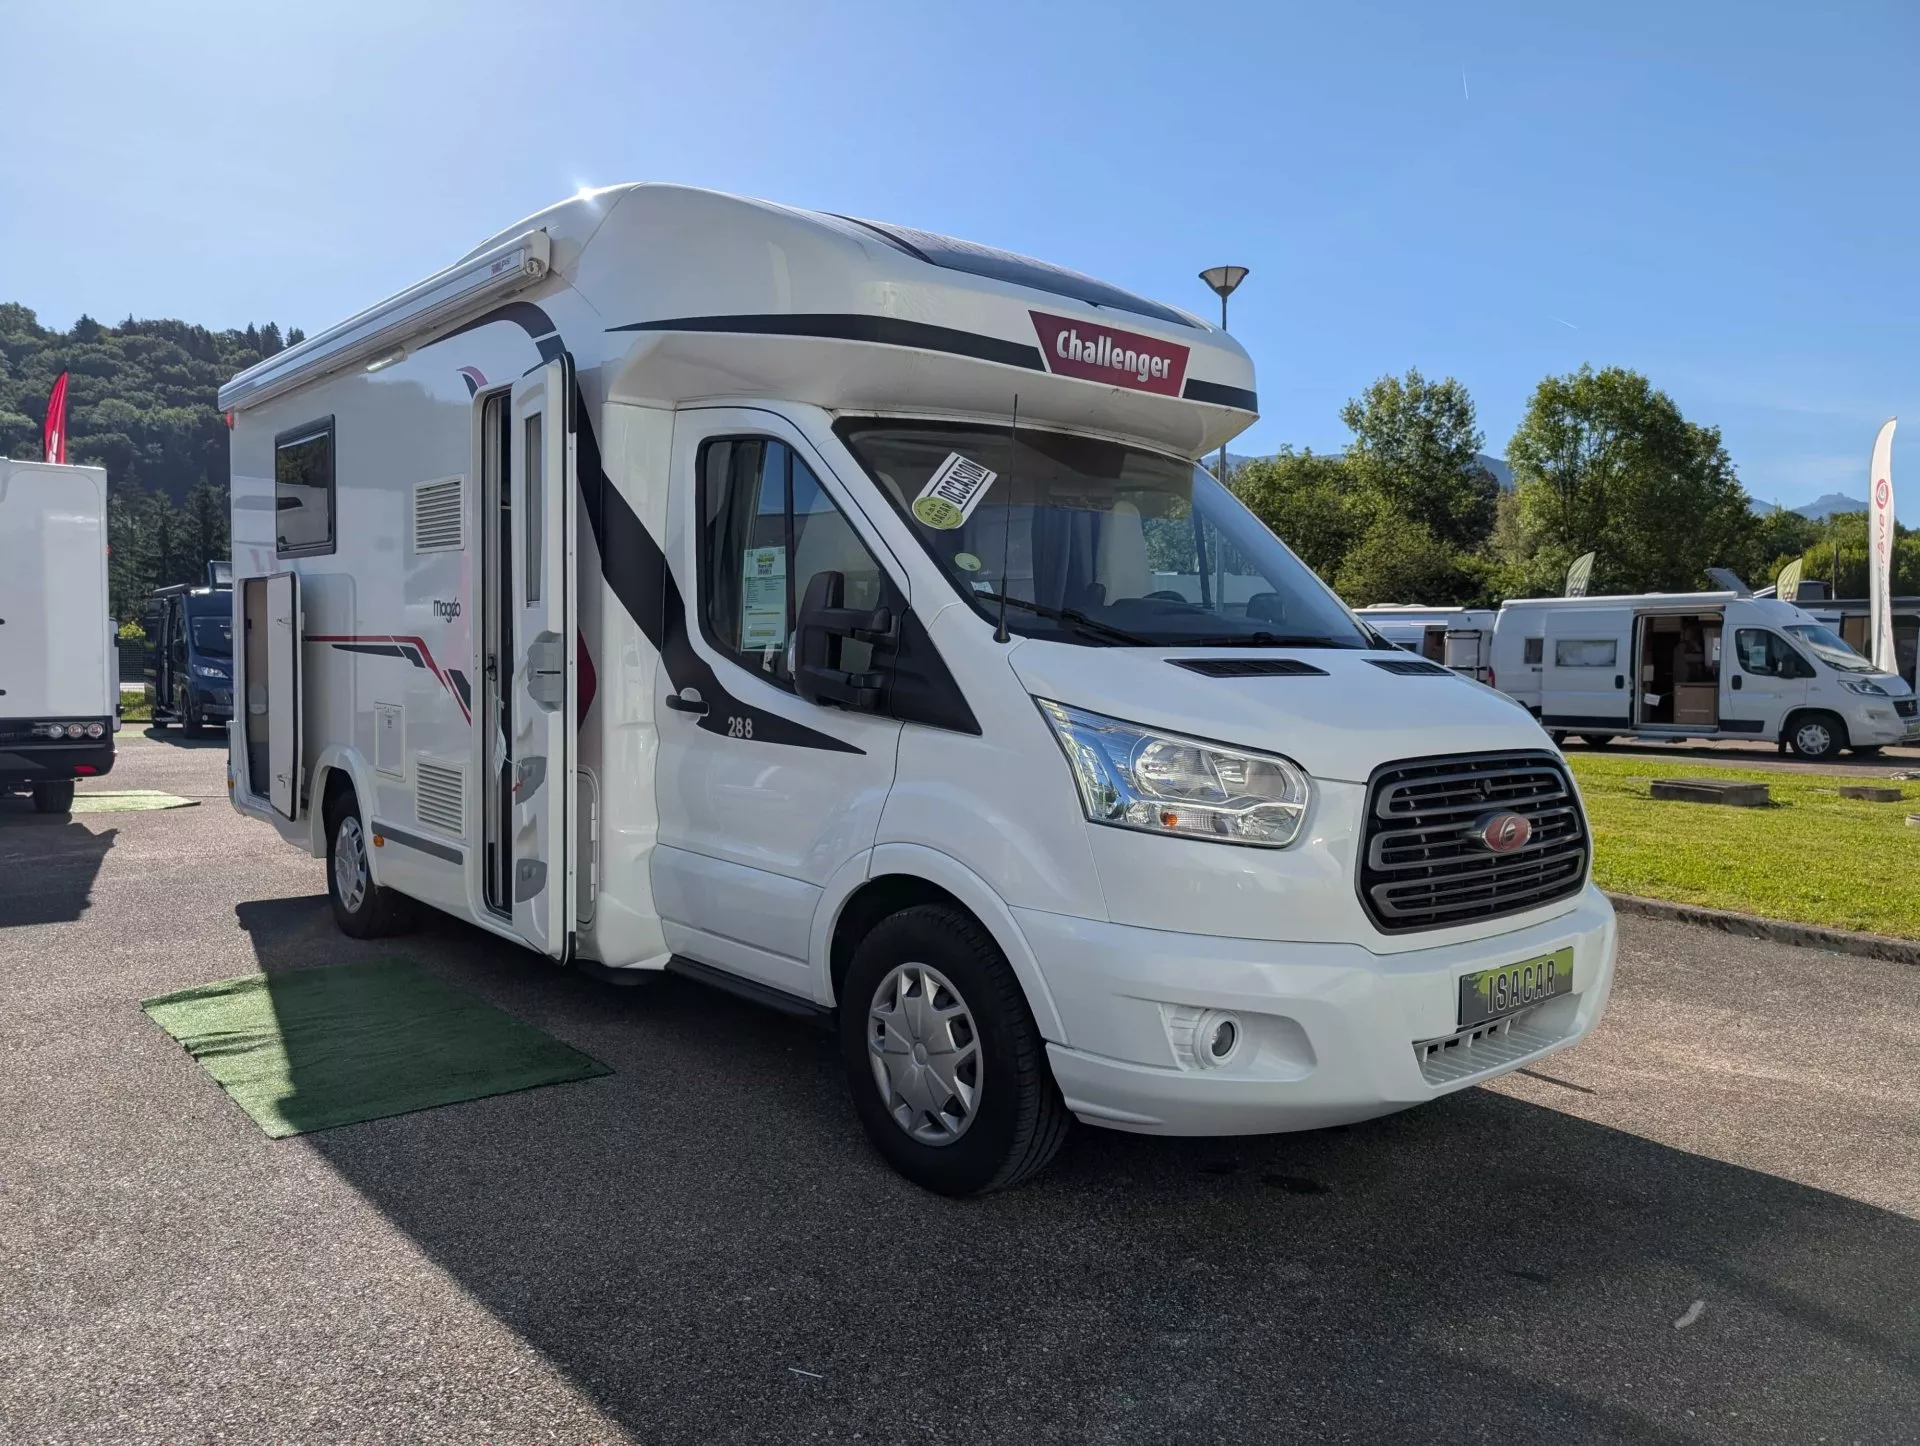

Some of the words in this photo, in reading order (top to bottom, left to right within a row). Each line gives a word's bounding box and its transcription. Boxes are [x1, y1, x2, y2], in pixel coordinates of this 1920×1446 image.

[1056, 329, 1171, 382] Challenger
[937, 459, 986, 505] OCCASION
[929, 503, 953, 525] ISACAR
[727, 716, 753, 739] 288
[1487, 959, 1556, 1014] ISACAR
